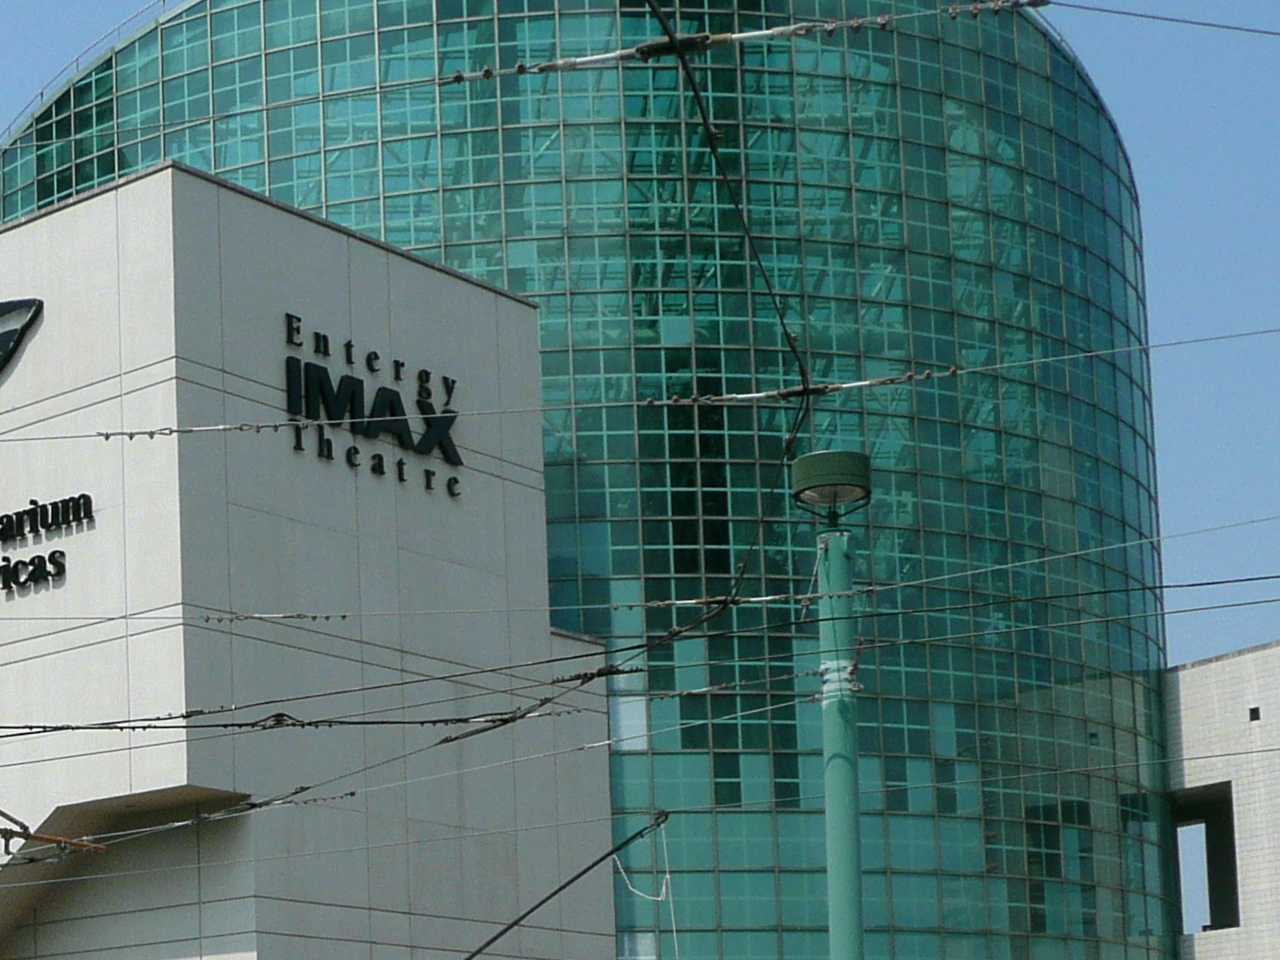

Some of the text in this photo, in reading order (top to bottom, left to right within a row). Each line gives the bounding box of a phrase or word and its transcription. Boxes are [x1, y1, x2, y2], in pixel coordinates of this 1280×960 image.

[285, 312, 457, 407] Entergy
[286, 355, 464, 466] IMAX
[288, 417, 461, 498] Theatre
